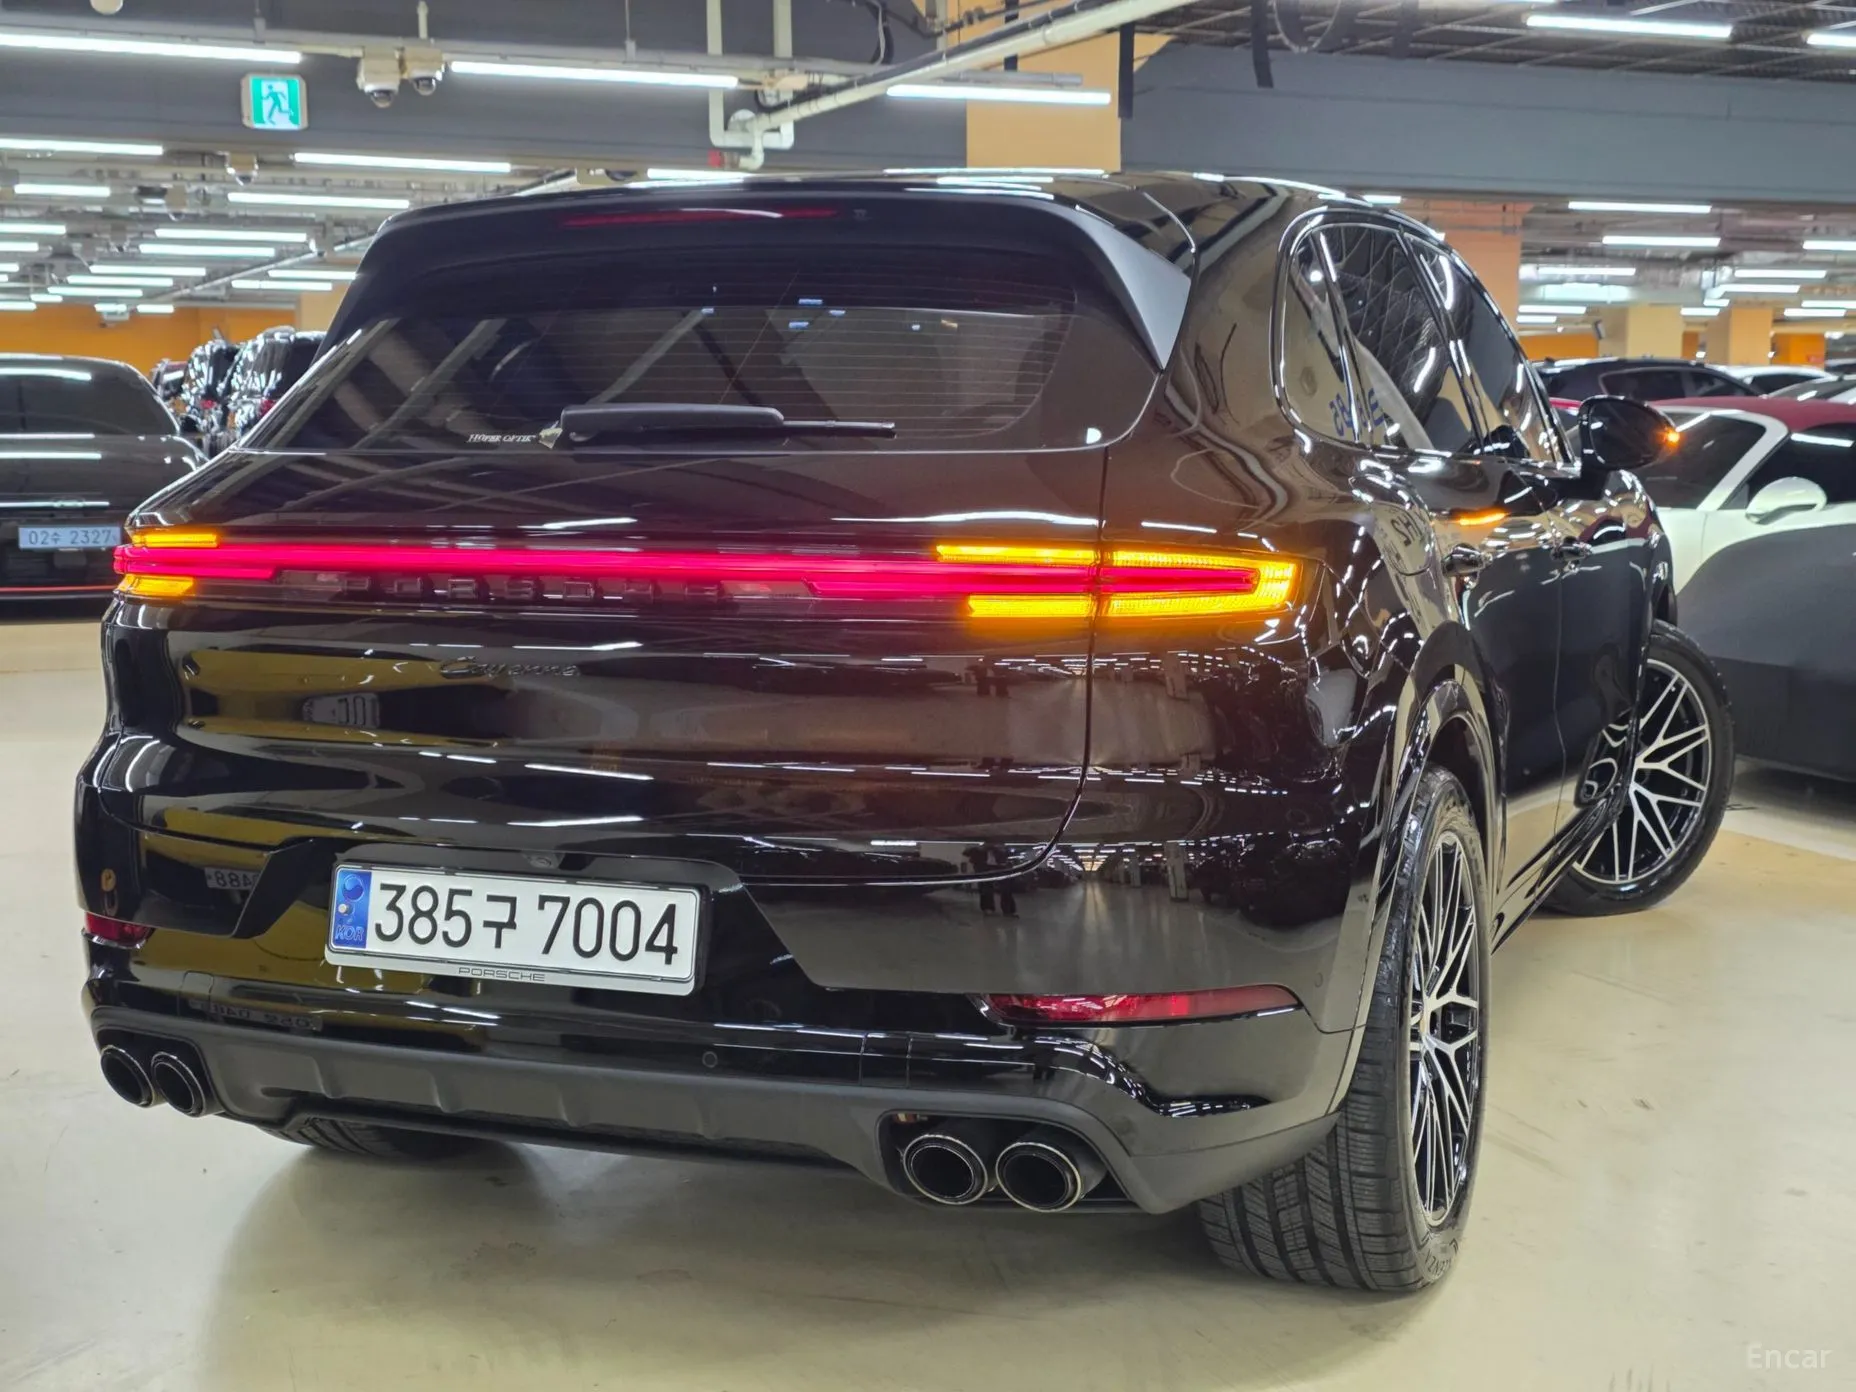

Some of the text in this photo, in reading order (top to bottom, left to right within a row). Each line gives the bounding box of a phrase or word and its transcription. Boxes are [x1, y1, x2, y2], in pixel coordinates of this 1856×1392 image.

[69, 529, 112, 545] 2327
[374, 883, 678, 965] 385구 7004
[334, 924, 365, 941] KOR
[458, 966, 546, 982] PORSCHE
